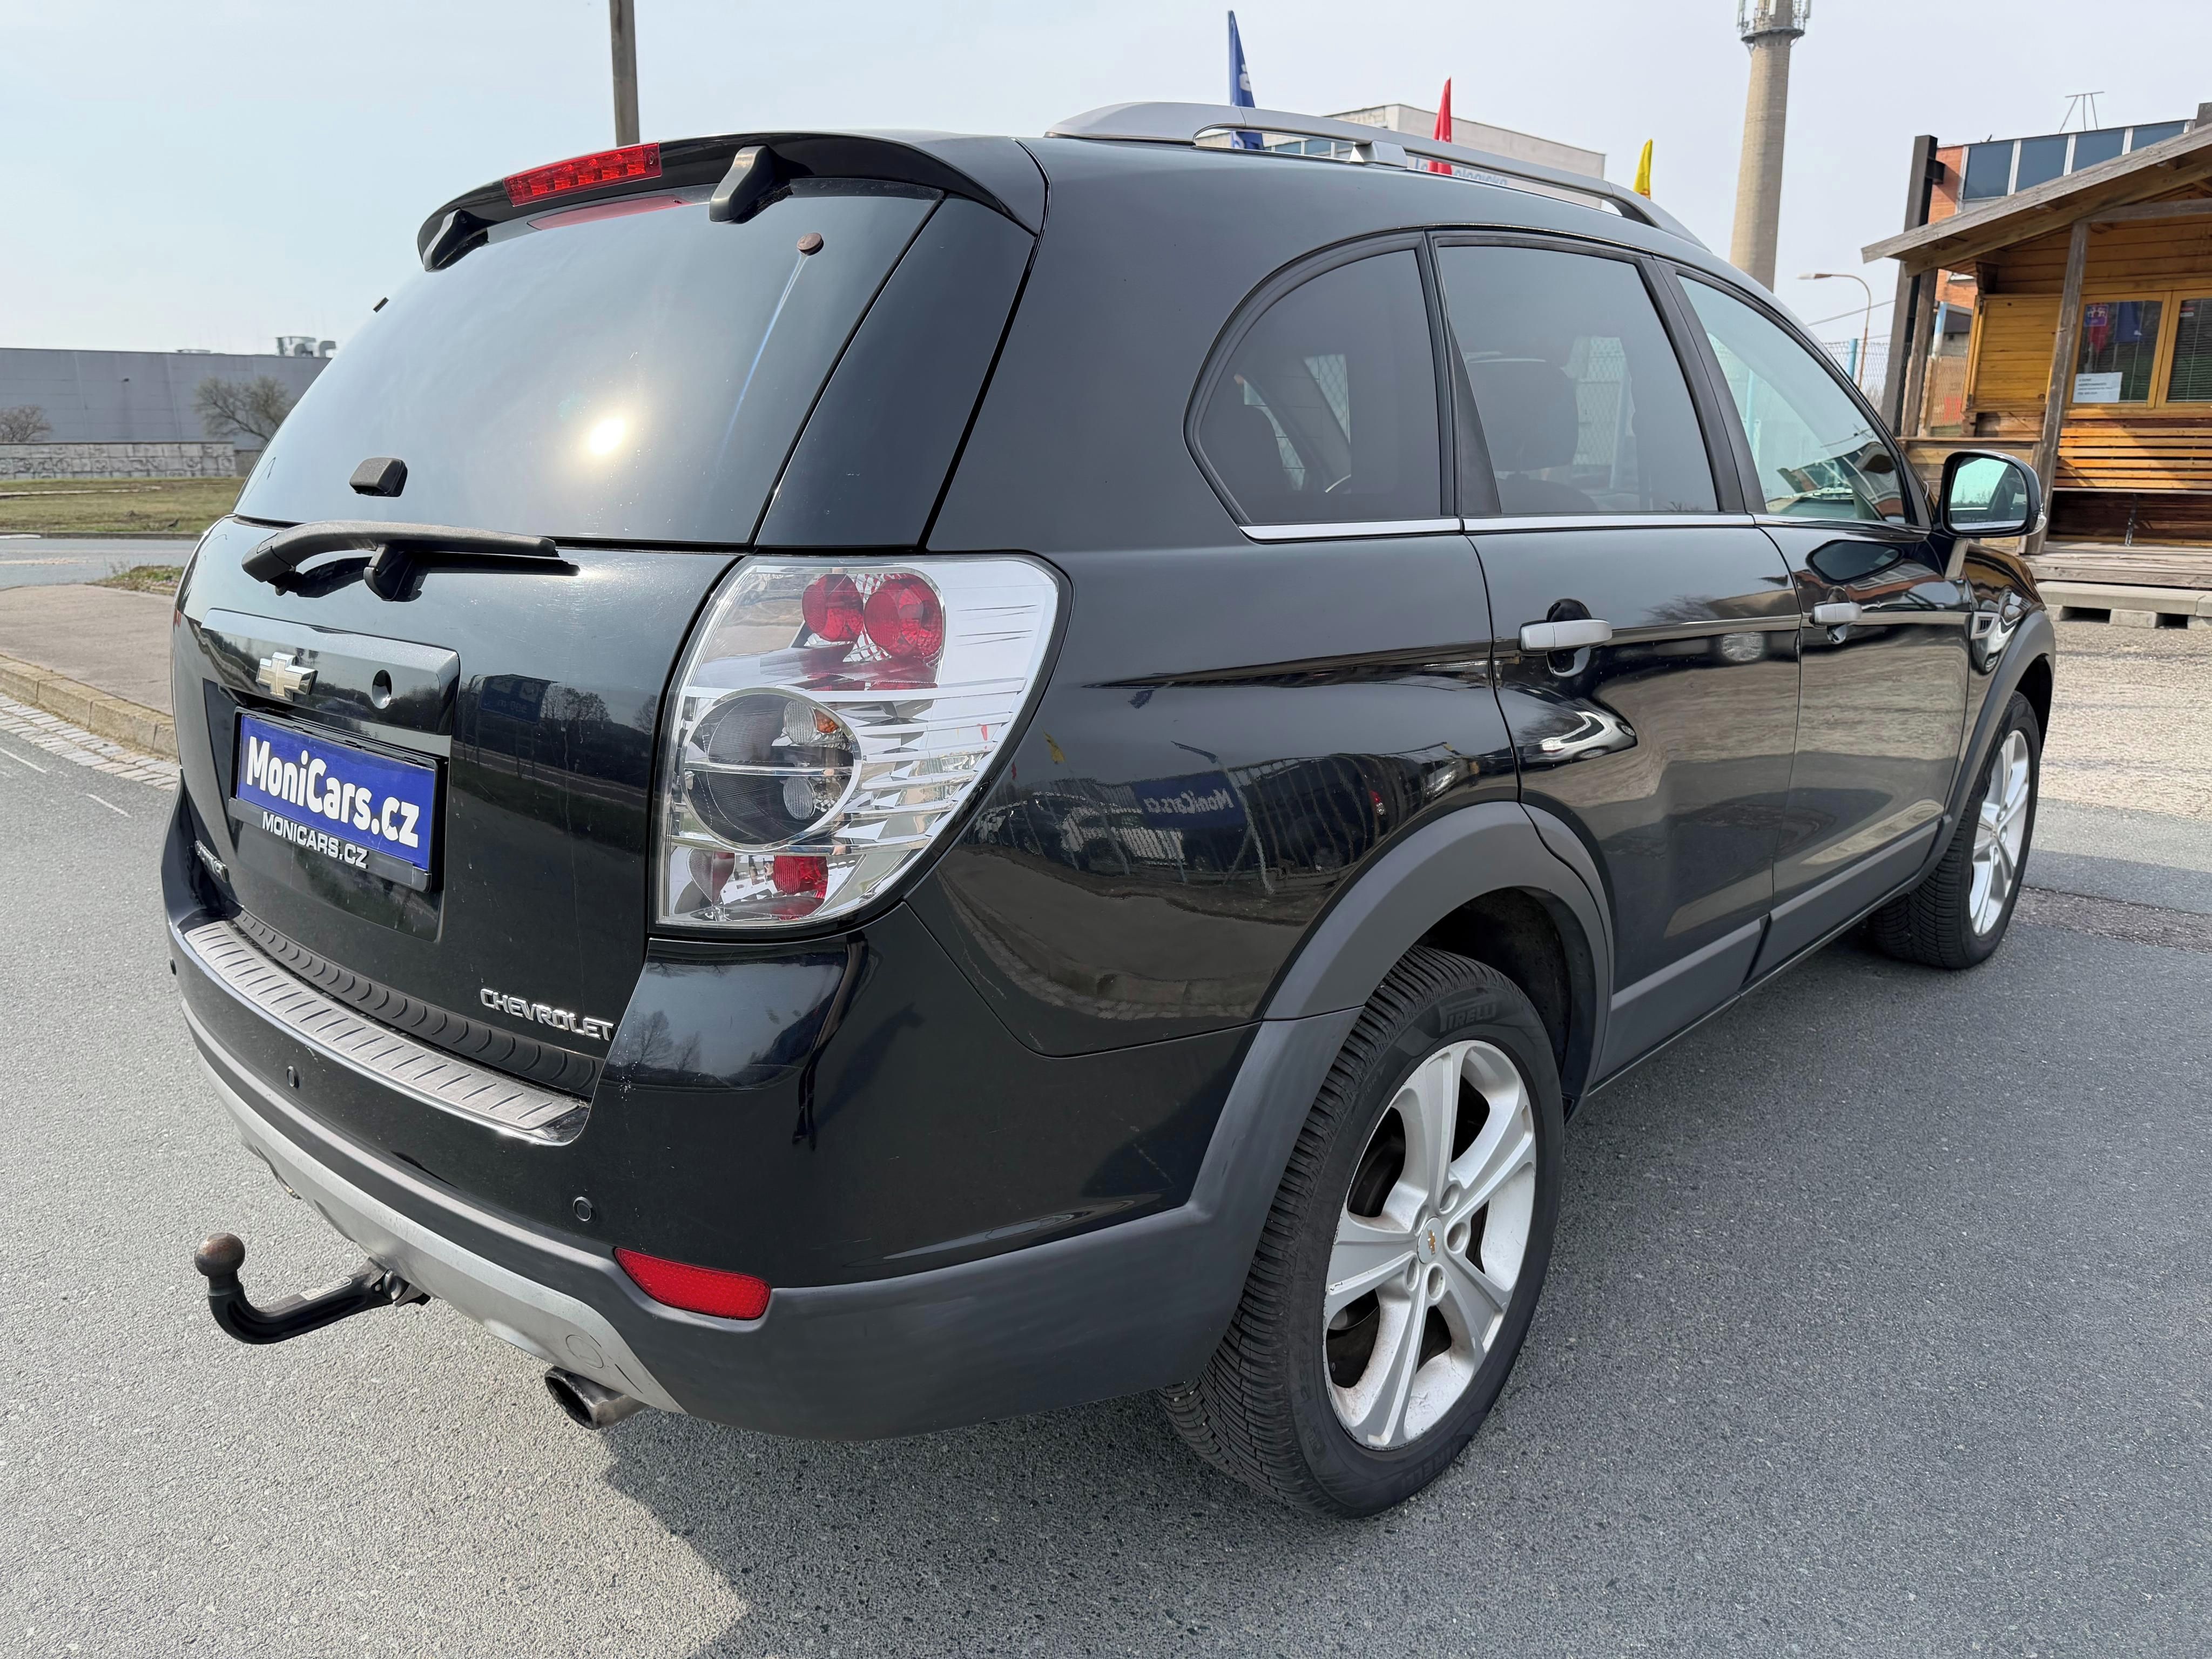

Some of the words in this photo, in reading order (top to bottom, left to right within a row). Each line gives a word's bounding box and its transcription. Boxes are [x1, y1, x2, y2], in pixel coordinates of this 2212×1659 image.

[246, 736, 420, 848] MoniCars.cz
[262, 811, 368, 869] MONICARS.CZ
[480, 988, 614, 1041] CHEVROLET
[1438, 993, 1497, 1033] PIRELLI
